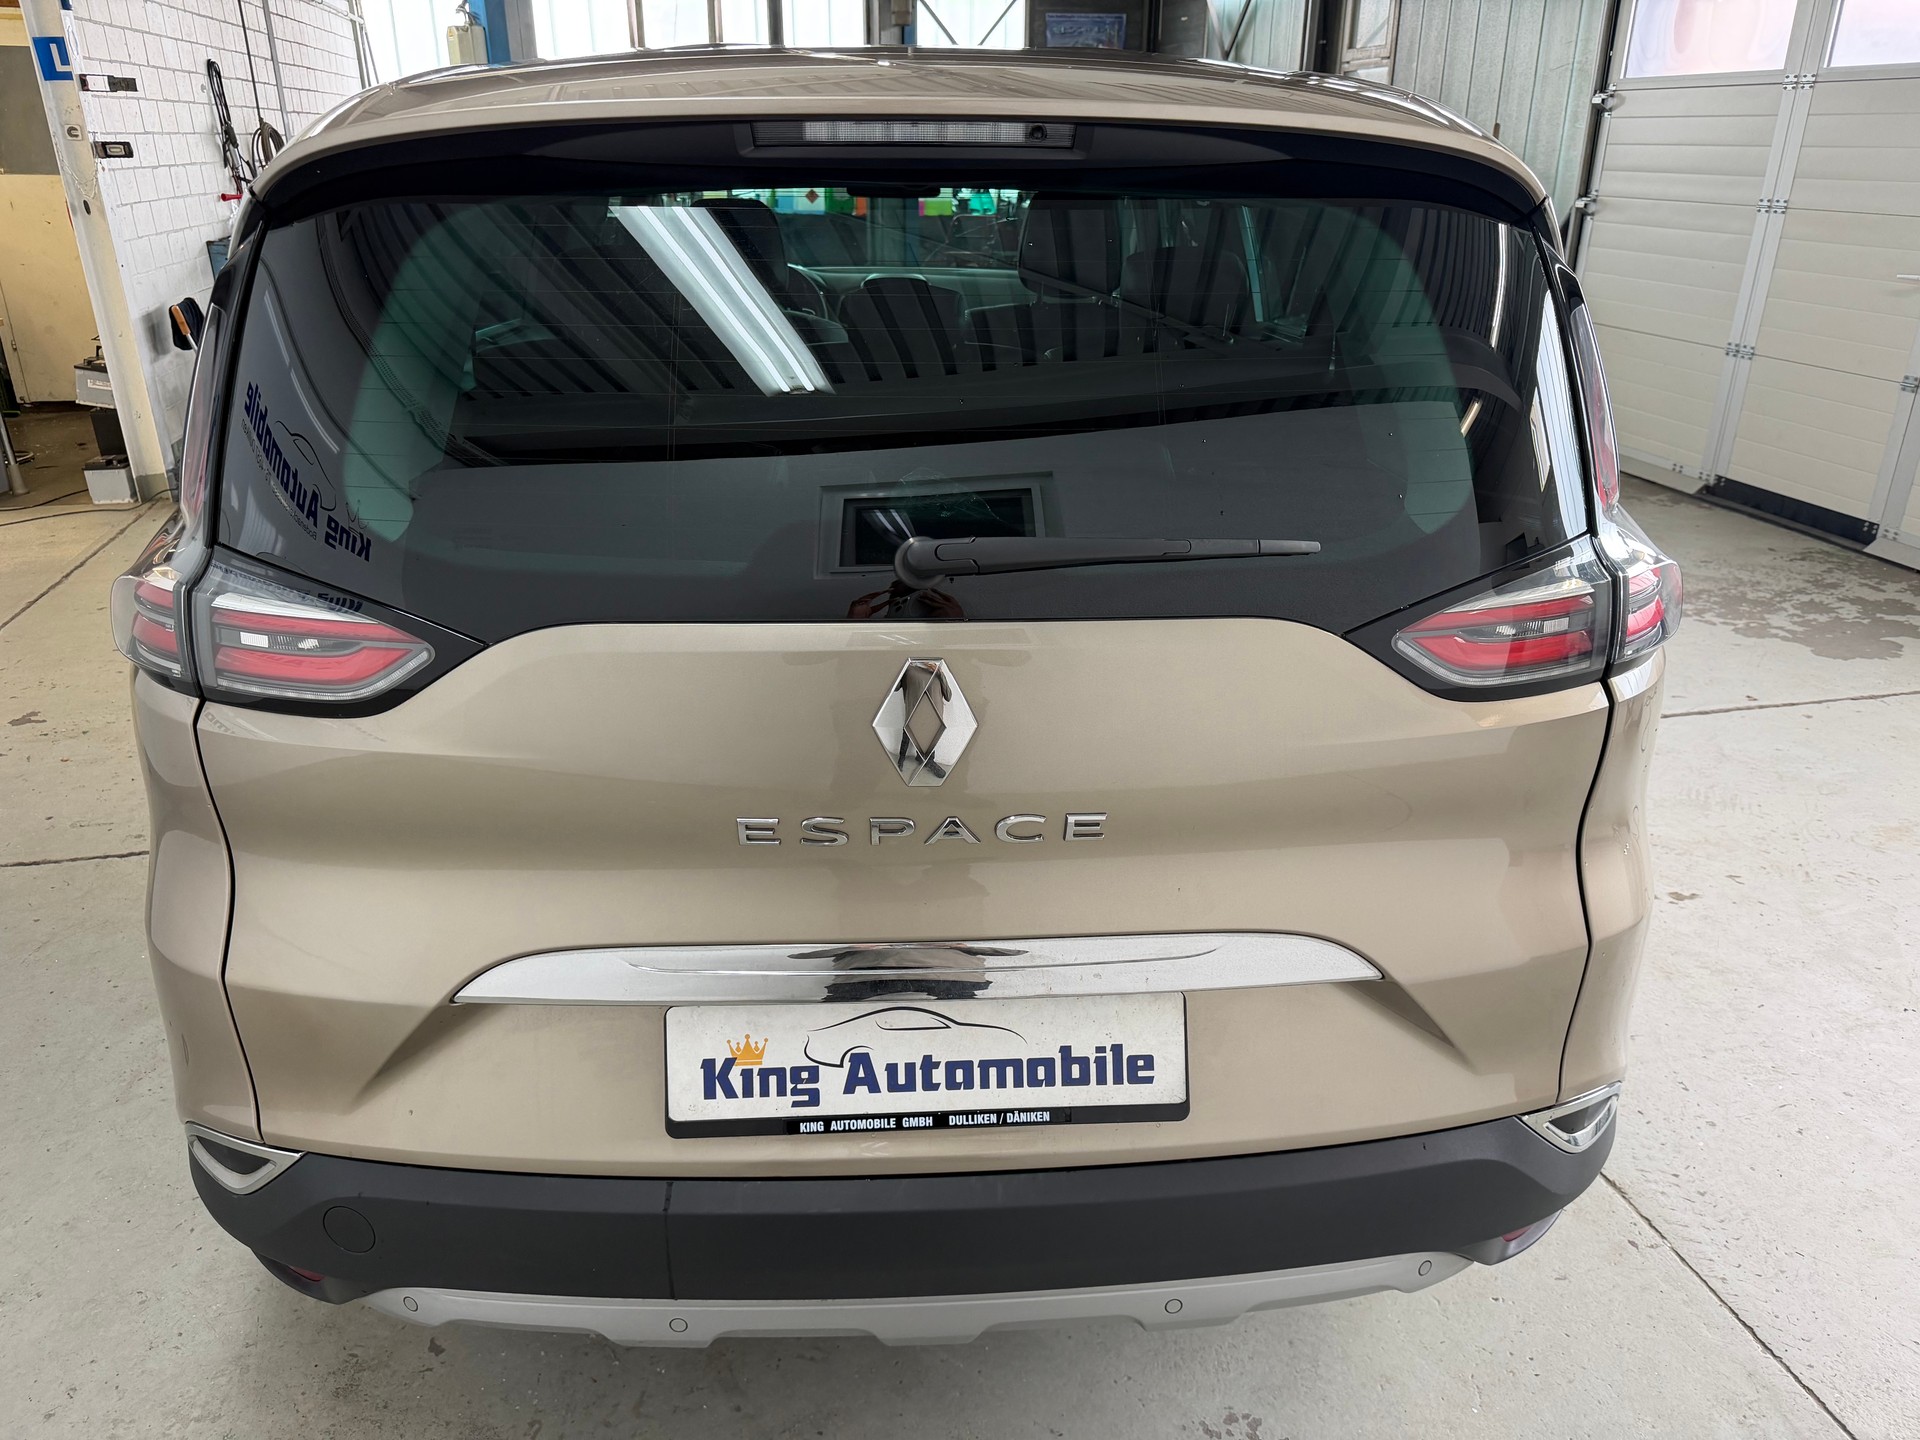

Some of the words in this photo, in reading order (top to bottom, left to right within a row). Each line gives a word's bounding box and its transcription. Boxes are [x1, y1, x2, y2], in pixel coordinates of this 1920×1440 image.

[737, 813, 1108, 846] ESPACE
[700, 1056, 820, 1108] King
[842, 1043, 1155, 1095] Automobile
[799, 1121, 824, 1133] KING
[830, 1118, 896, 1131] AUTOMOBILE
[902, 1116, 933, 1129] GMBH
[949, 1113, 997, 1125] DULLIKEN
[1007, 1110, 1050, 1124] DÄNIKEN
